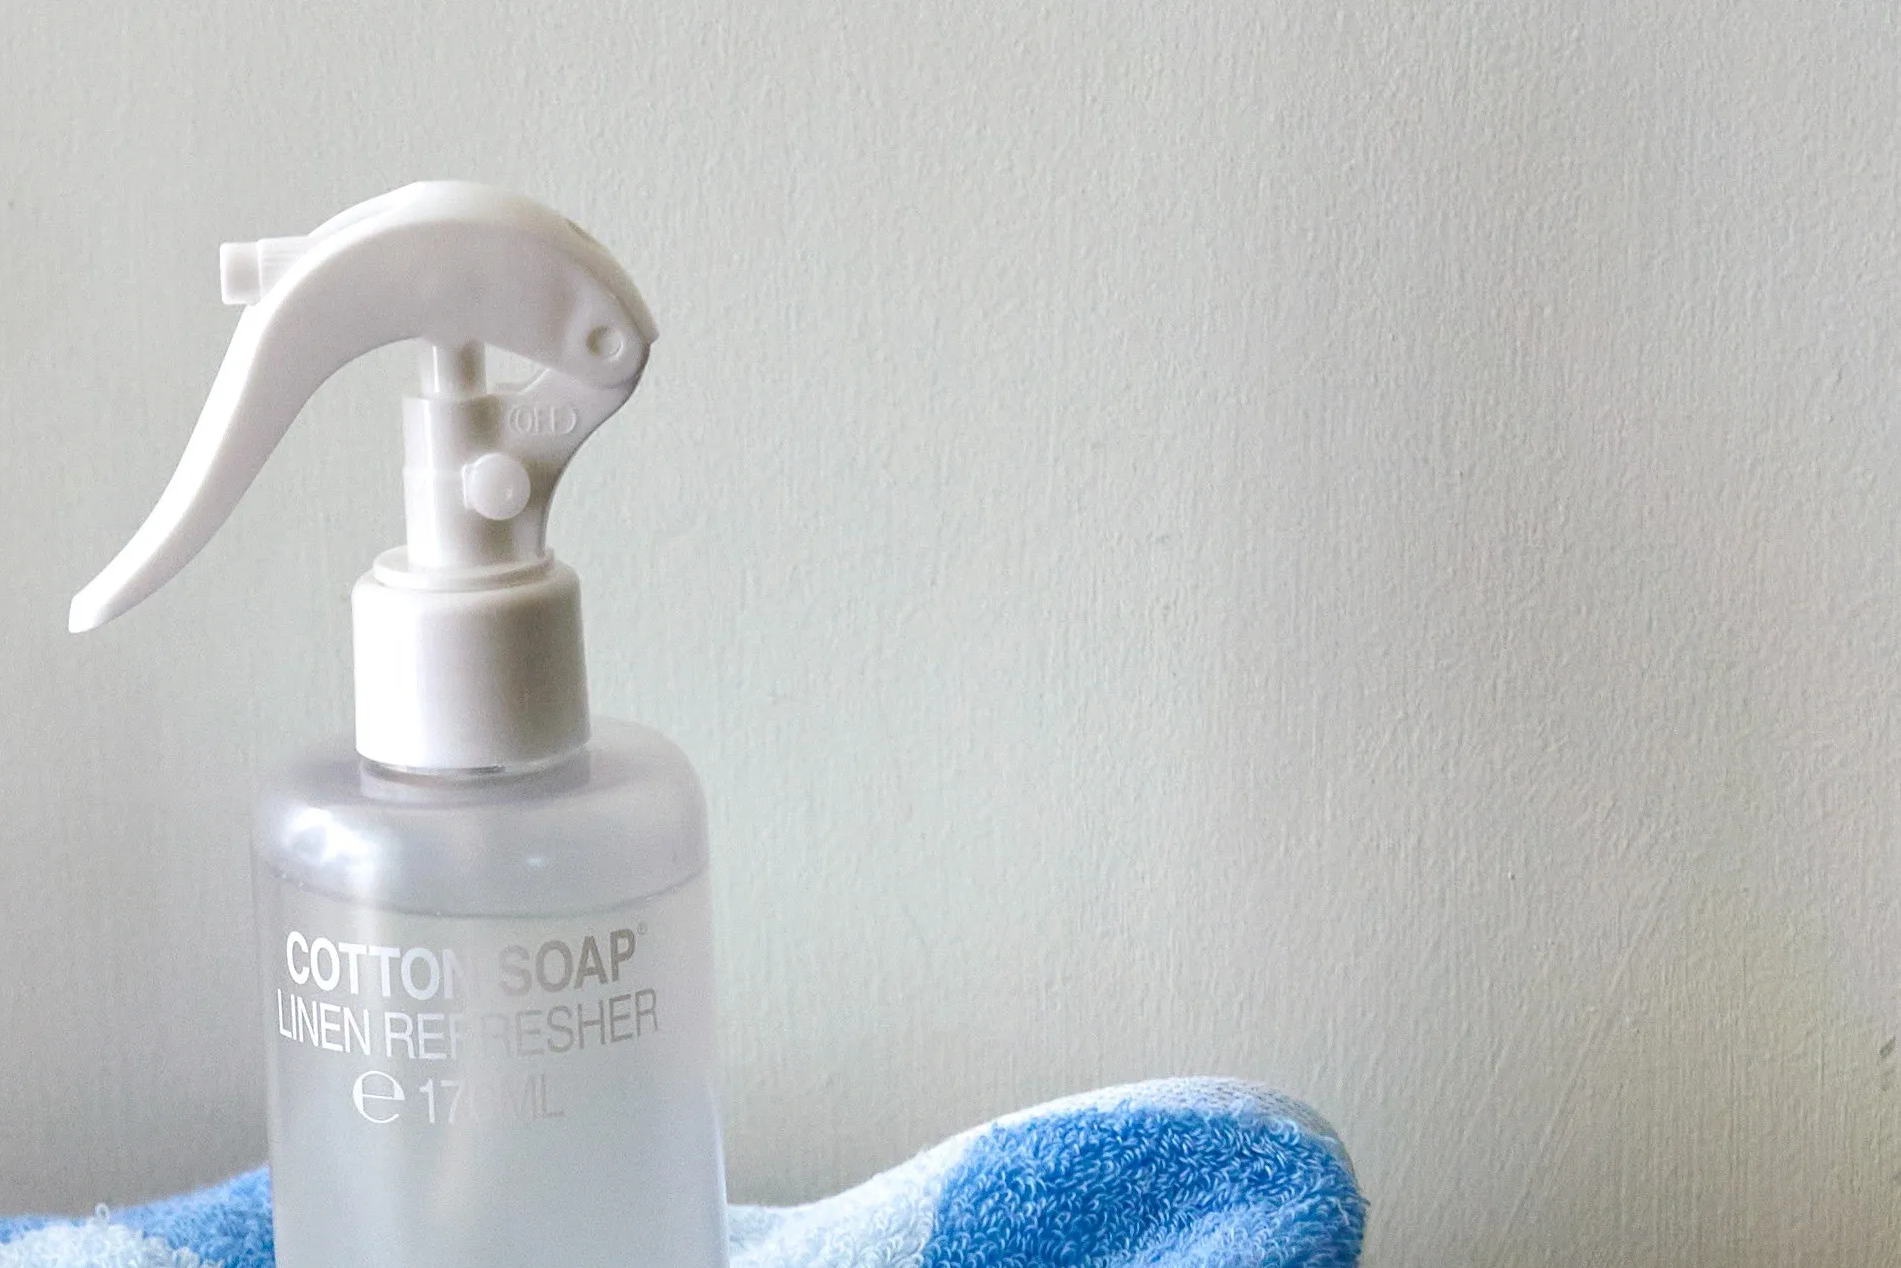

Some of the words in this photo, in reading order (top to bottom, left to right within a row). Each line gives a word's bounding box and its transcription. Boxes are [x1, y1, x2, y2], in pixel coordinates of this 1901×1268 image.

[286, 931, 479, 1000] COTTON
[277, 988, 370, 1056] LINEN
[385, 988, 659, 1061] REFRESHER
